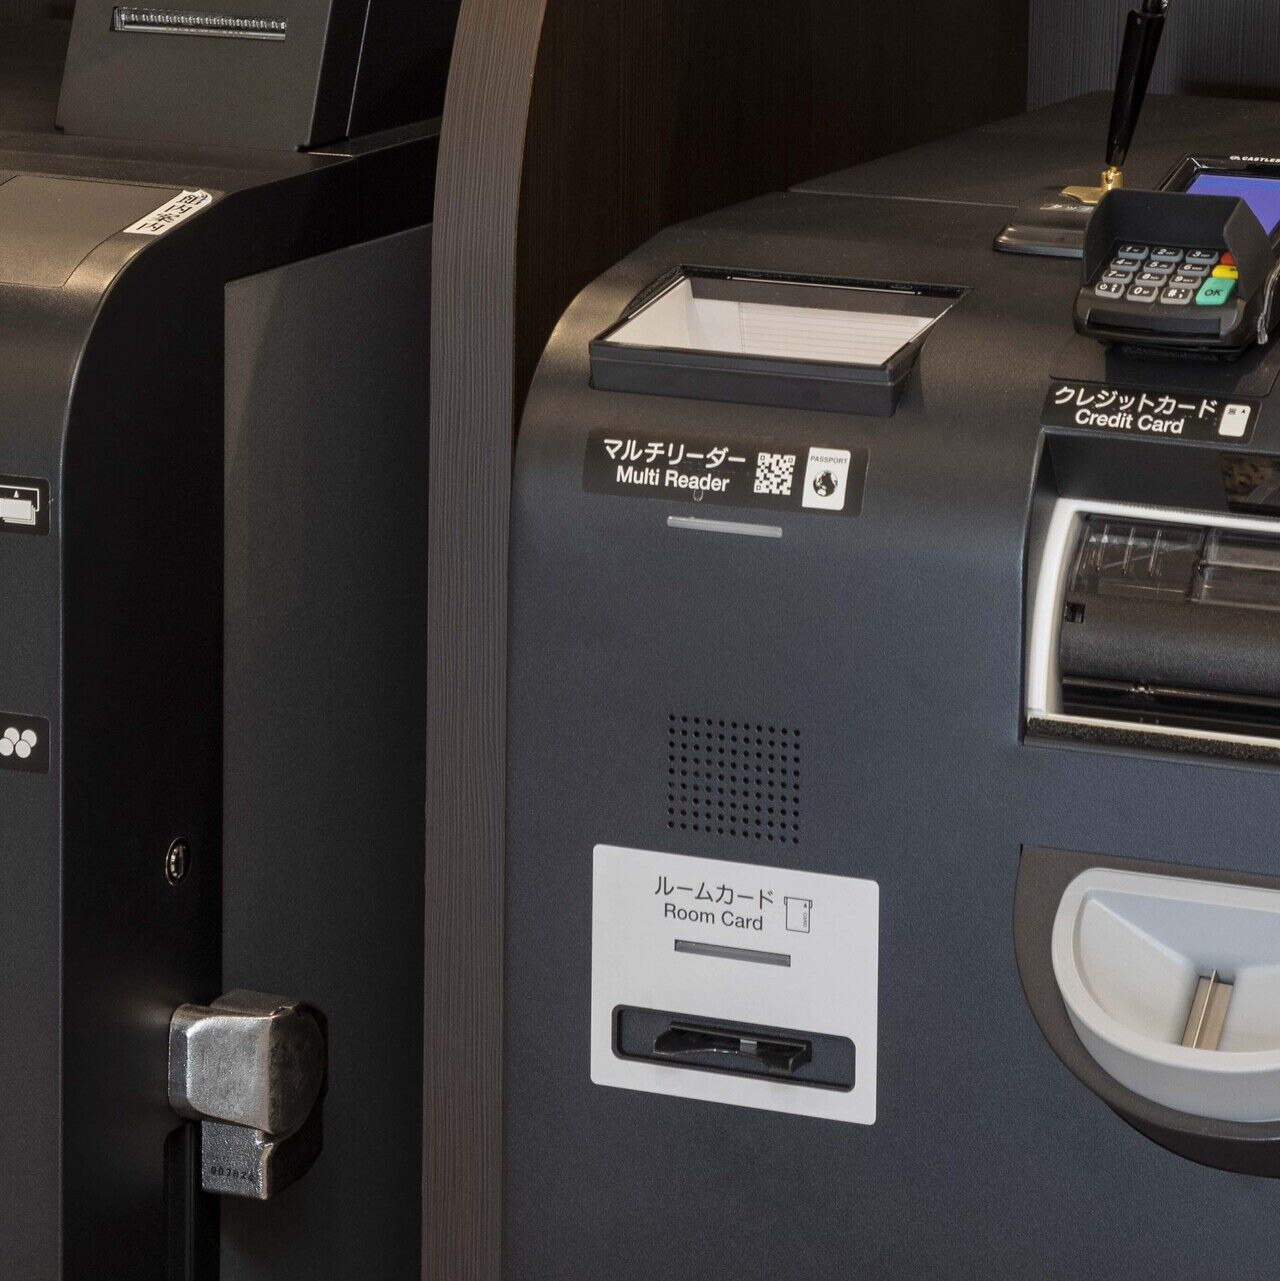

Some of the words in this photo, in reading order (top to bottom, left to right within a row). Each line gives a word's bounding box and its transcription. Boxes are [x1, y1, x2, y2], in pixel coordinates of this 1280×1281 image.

[1204, 288, 1223, 297] OK
[1054, 385, 1218, 419] クレジットカード
[1075, 408, 1132, 430] Credit
[1137, 414, 1185, 434] Card
[604, 438, 746, 469] マルチリーダー
[810, 455, 849, 464] PASSPORT
[616, 465, 660, 487] Multi
[665, 470, 730, 492] Reader
[655, 875, 774, 910] ルームカード
[664, 903, 716, 925] Room
[721, 910, 763, 931] Card
